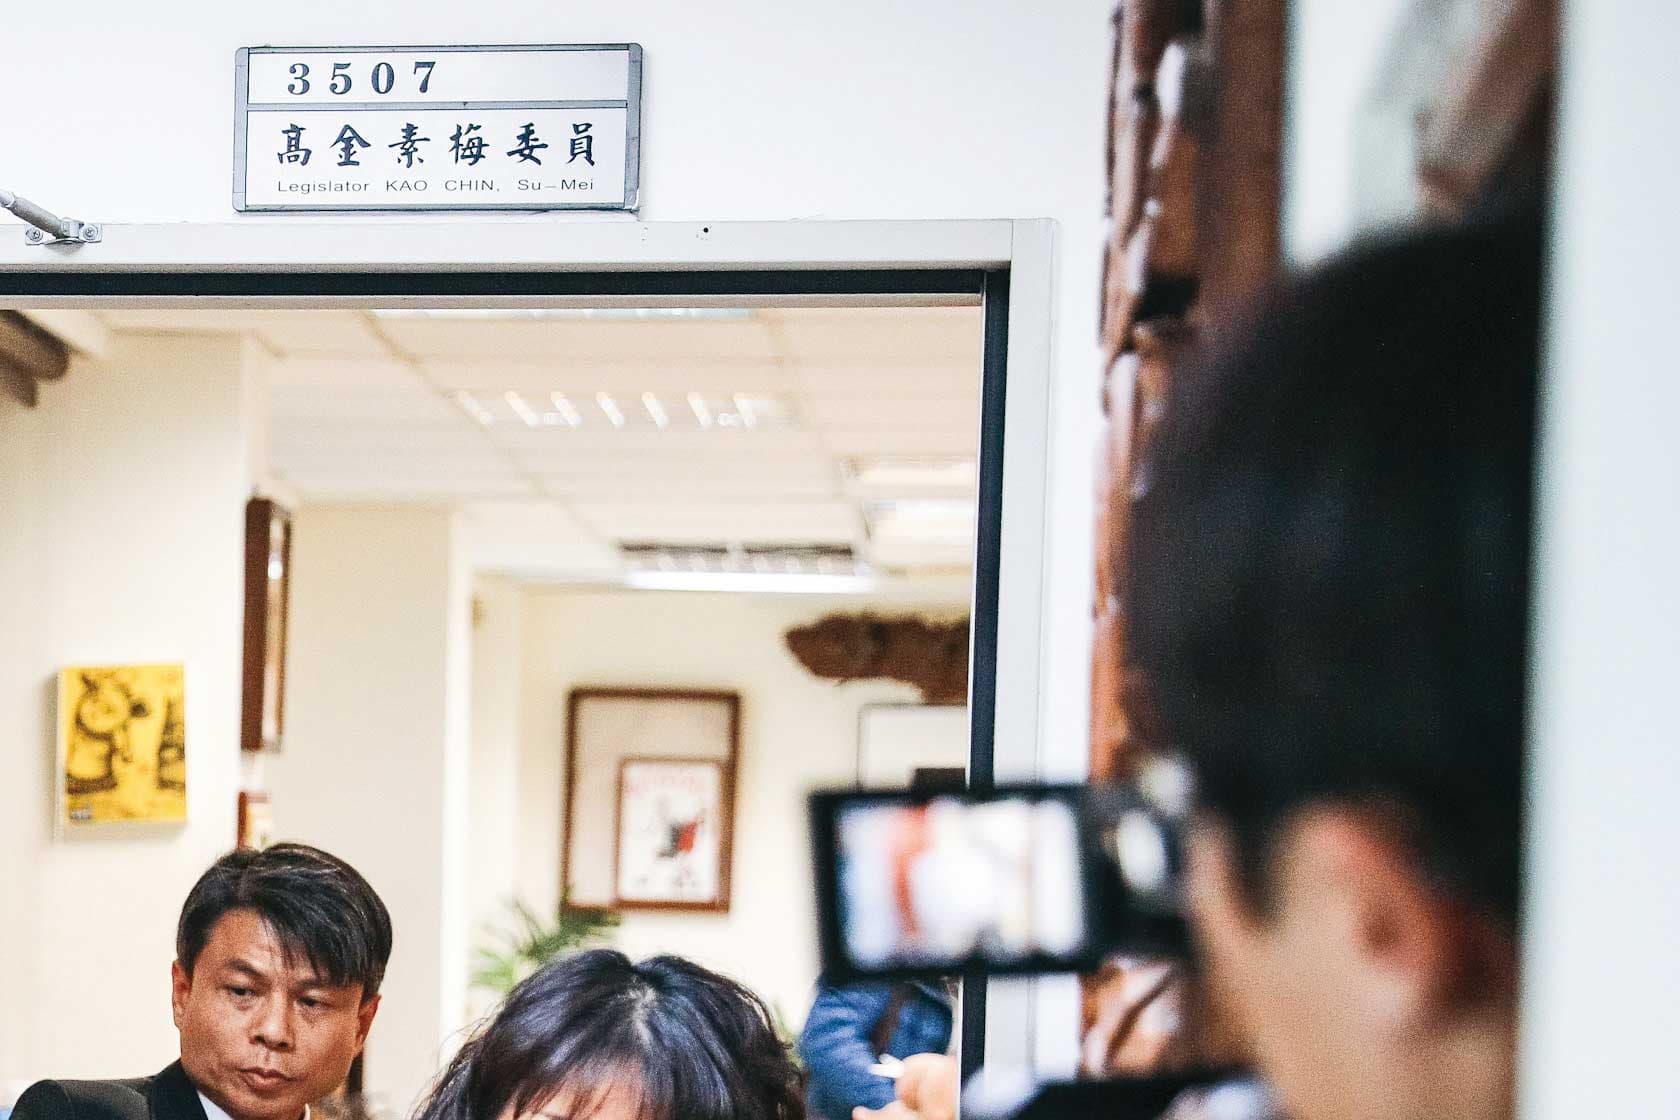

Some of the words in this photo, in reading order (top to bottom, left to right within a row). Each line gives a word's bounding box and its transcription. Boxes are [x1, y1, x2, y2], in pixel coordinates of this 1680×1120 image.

[287, 61, 437, 96] 3507
[277, 179, 371, 195] Legislator
[386, 179, 428, 192] KAO
